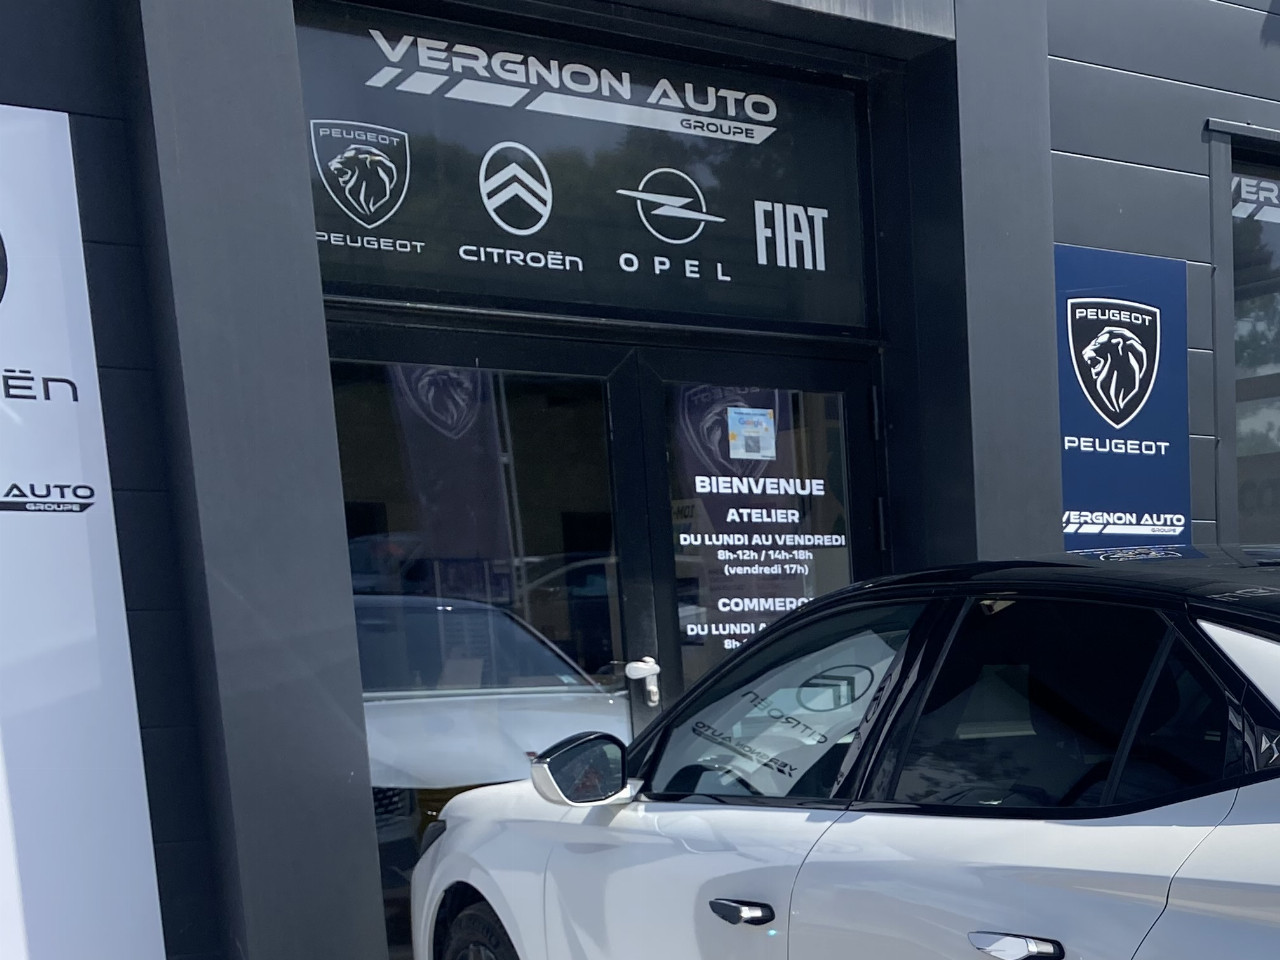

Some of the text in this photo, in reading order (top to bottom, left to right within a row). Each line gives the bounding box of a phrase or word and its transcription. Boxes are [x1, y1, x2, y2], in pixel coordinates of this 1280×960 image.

[368, 29, 778, 122] VERGNON AUTO
[318, 126, 400, 147] PEUGEOT
[680, 118, 755, 139] GROUPE
[315, 231, 425, 253] PEUGEOT
[754, 200, 828, 271] FIAT
[458, 244, 583, 271] CITROËN
[619, 252, 731, 282] OPEL
[1075, 308, 1152, 326] PEUGEOT
[1064, 436, 1170, 455] PEUGEOT
[3, 483, 95, 499] AUTO
[694, 475, 825, 496] BIENVENUE
[25, 503, 81, 511] GROUPE
[726, 508, 800, 523] ATELIER
[1140, 513, 1185, 526] AUTO
[679, 533, 846, 546] DU LUNDI AU VENDREDI
[717, 549, 813, 562] 8h-12h / 14h-18h
[724, 564, 809, 576] (vendredi 17h)
[686, 623, 708, 635] DU
[711, 622, 755, 635] LUNDI
